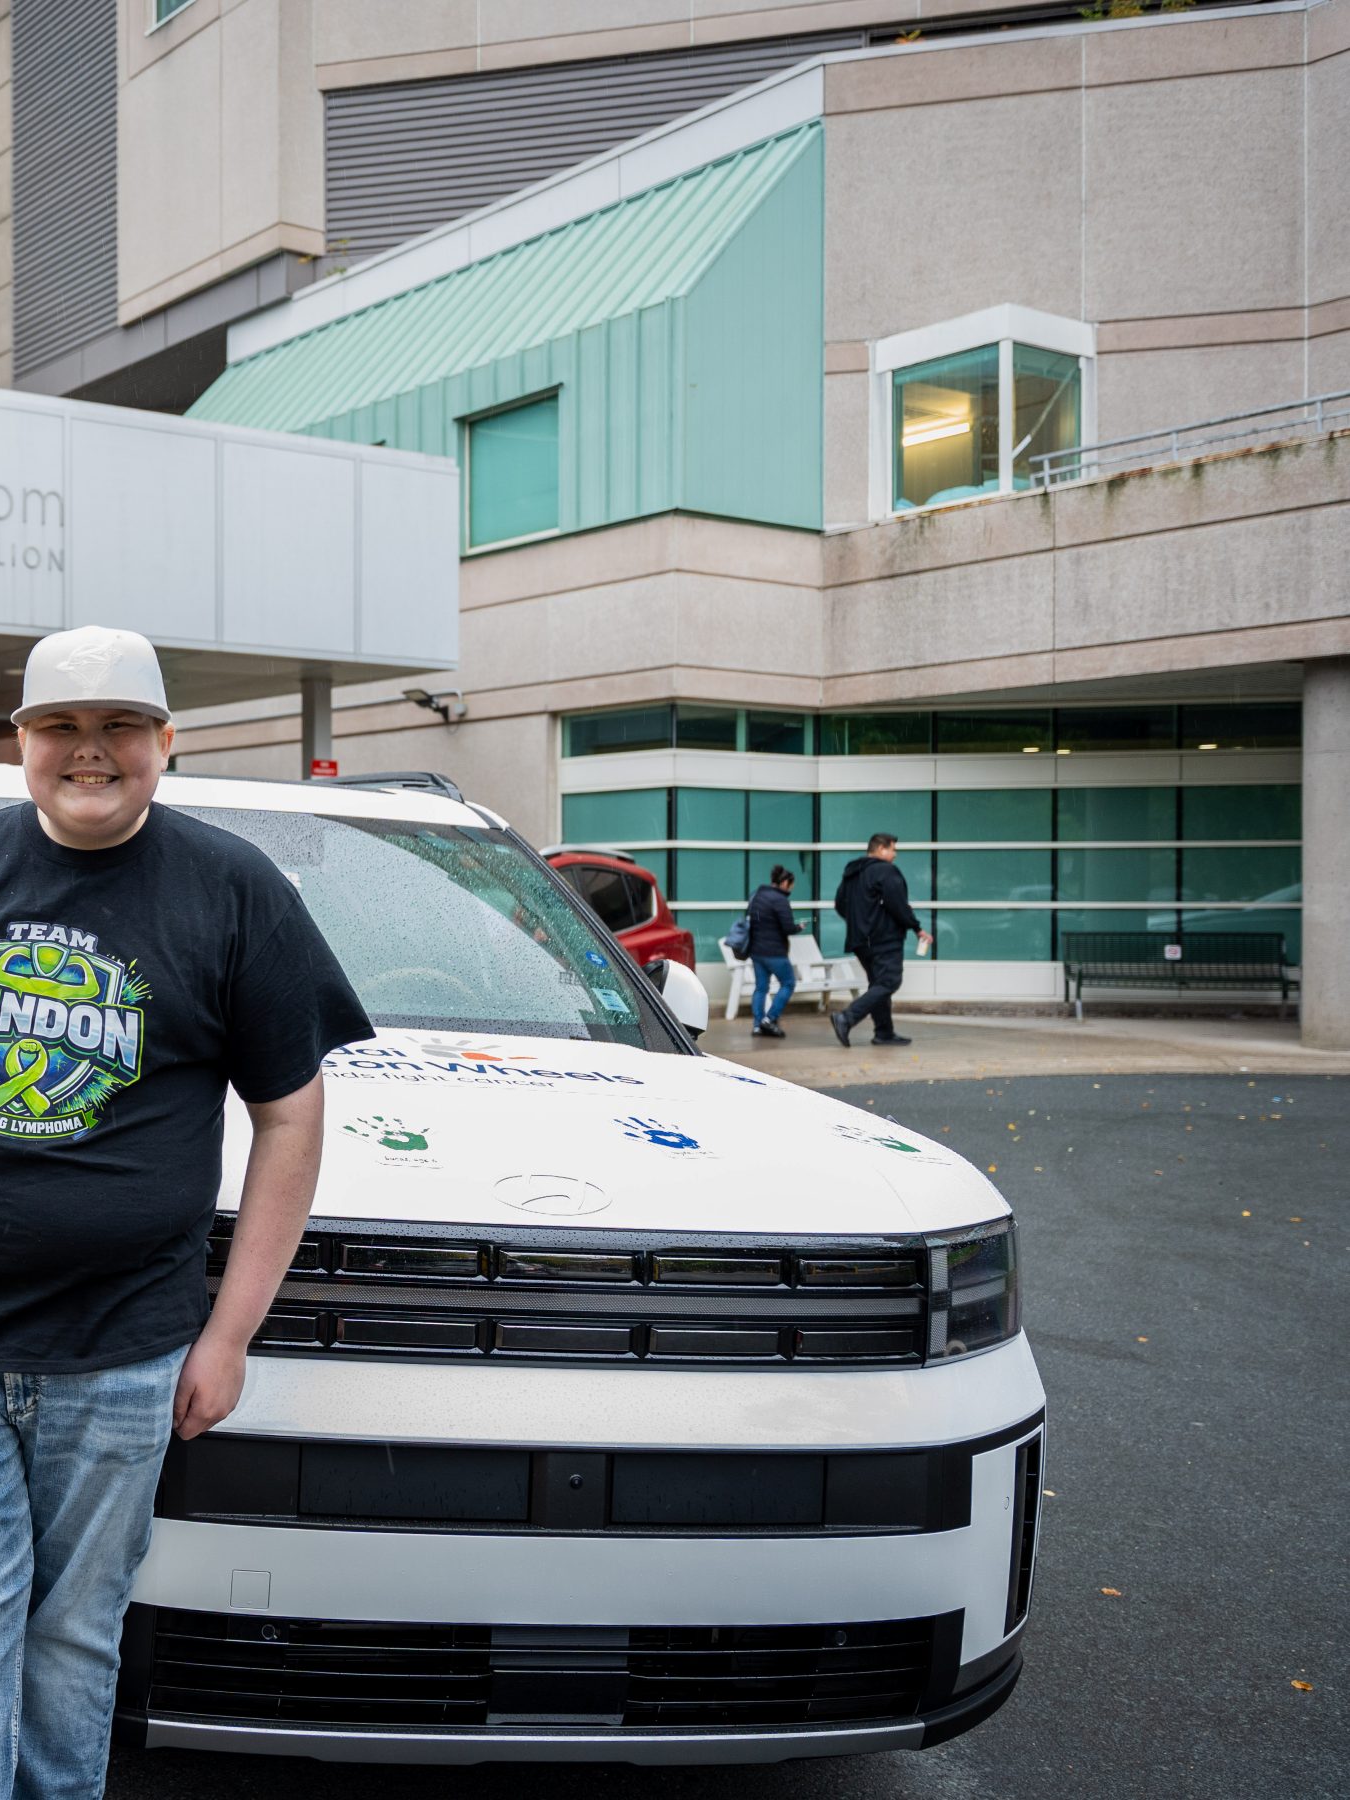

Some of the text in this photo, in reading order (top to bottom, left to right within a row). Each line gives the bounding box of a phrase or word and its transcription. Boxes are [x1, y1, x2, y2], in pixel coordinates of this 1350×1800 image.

[9, 923, 96, 953] TEAM
[348, 1060, 424, 1071] on
[424, 1060, 645, 1085] Wheels
[382, 1072, 449, 1082] fight
[457, 1076, 555, 1088] cancer
[10, 1117, 83, 1134] LYMPHOMA
